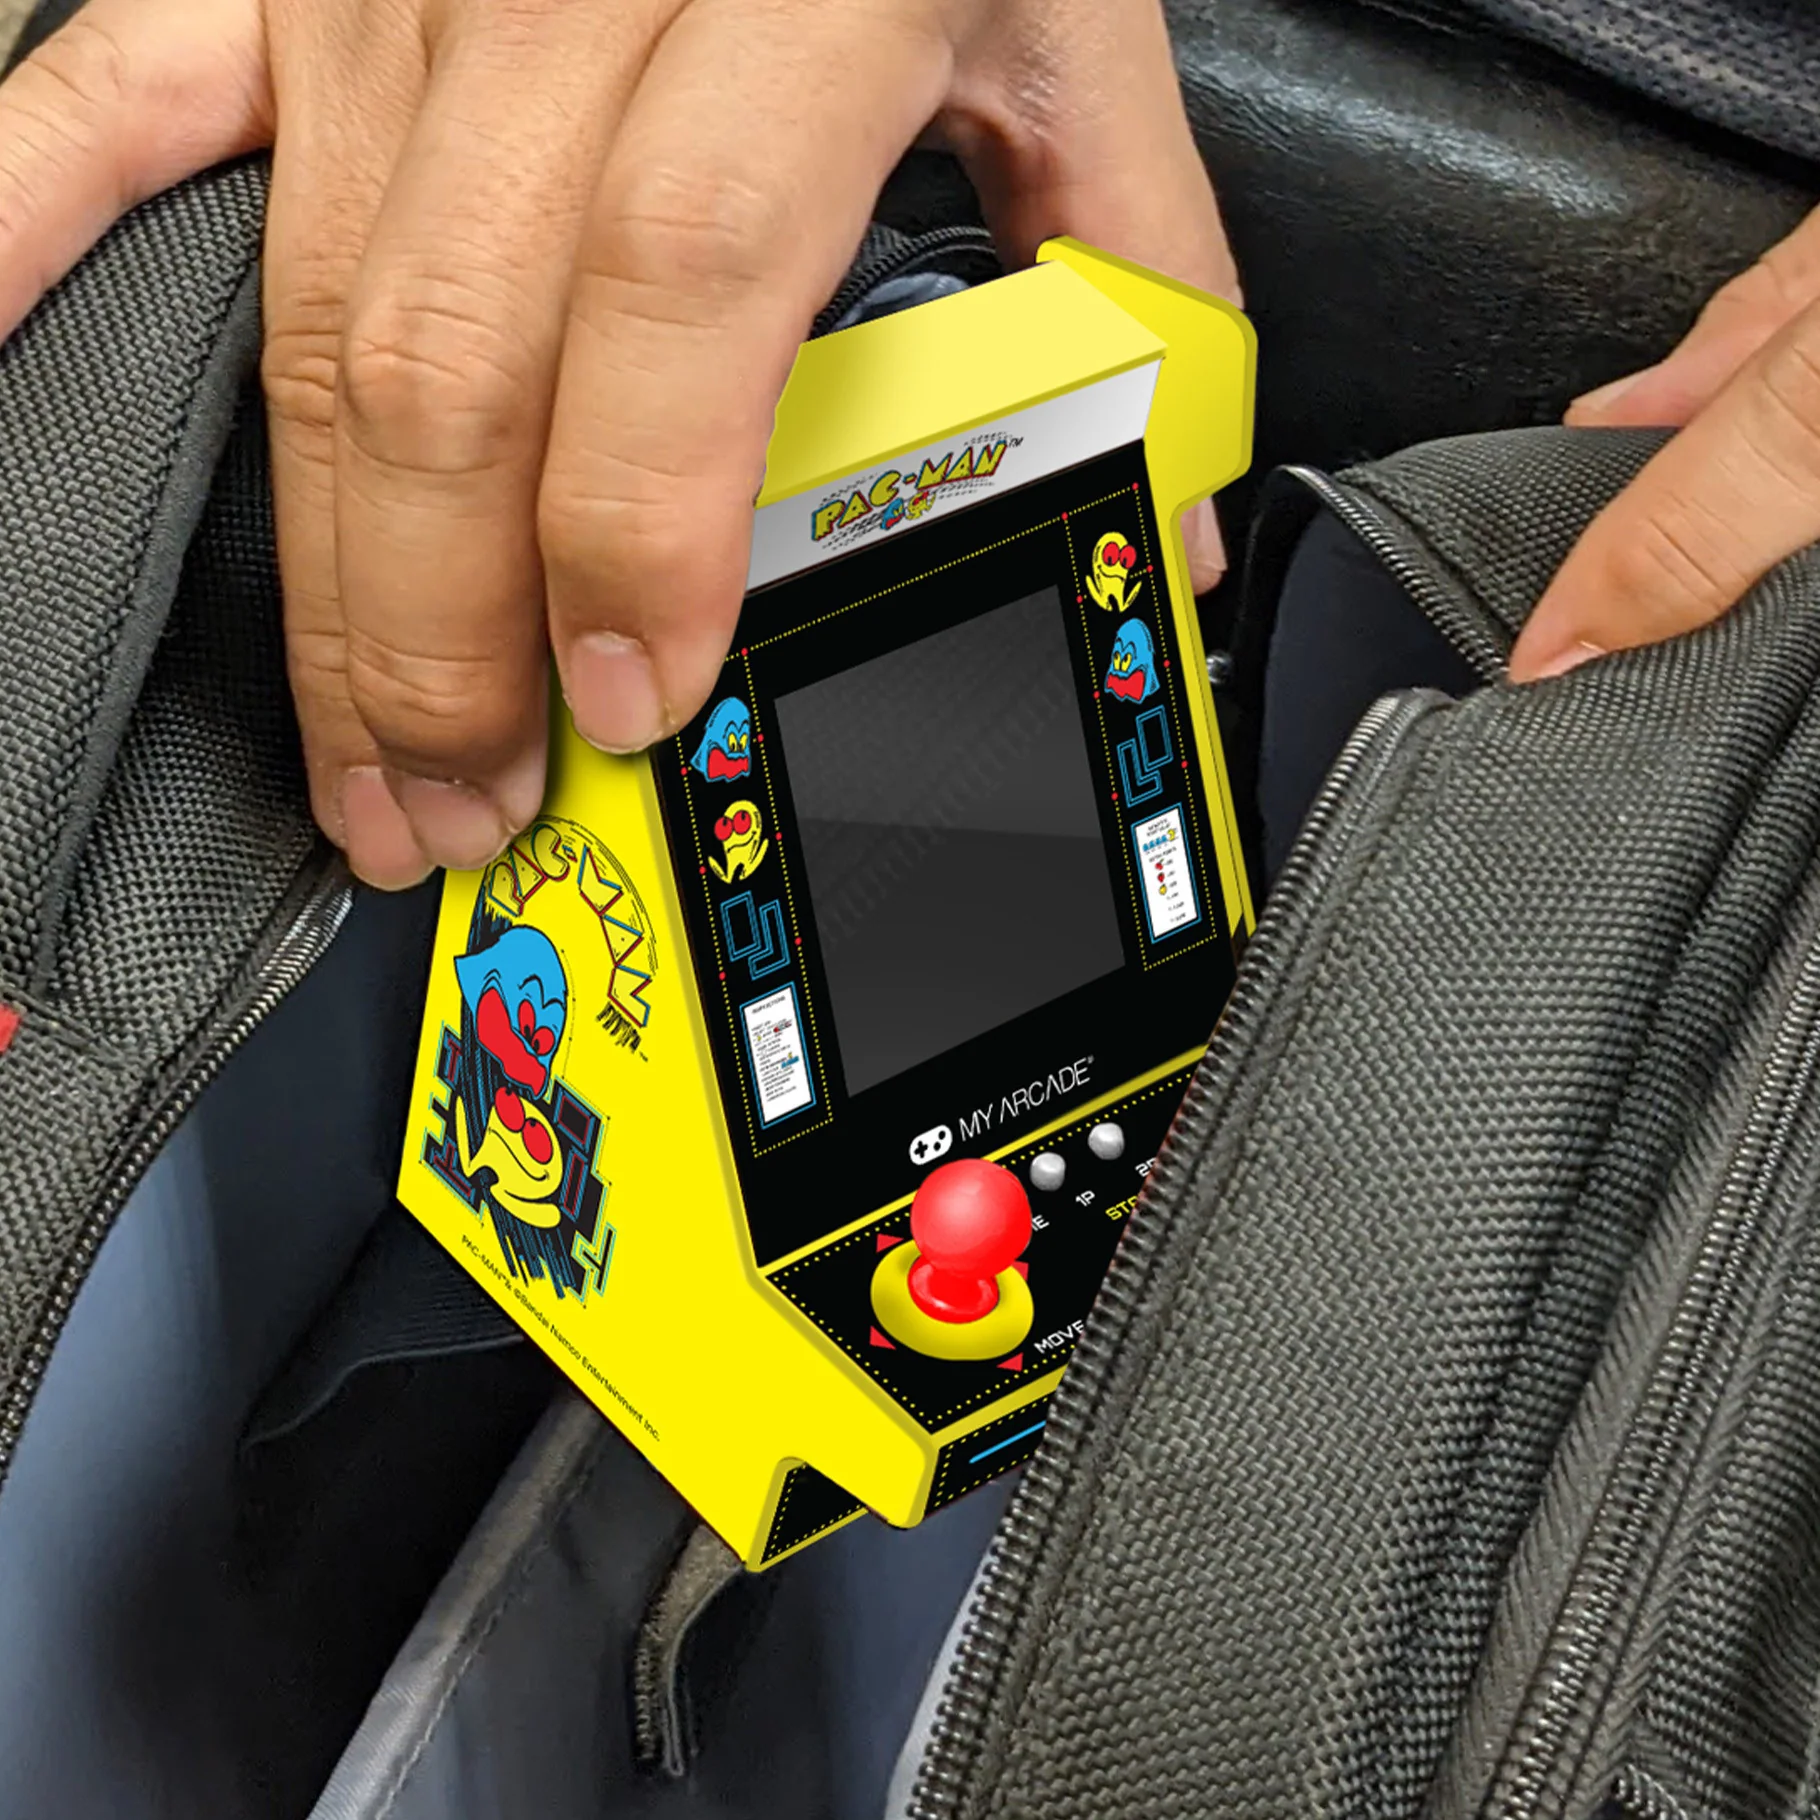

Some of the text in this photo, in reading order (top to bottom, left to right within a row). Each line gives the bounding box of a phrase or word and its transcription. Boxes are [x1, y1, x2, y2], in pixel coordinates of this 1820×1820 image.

[958, 1103, 994, 1142] MY
[1075, 1190, 1096, 1207] 1P
[1033, 1319, 1085, 1354] MOVE
[582, 1356, 643, 1424] Entertainment
[644, 1420, 660, 1442] Inc.
